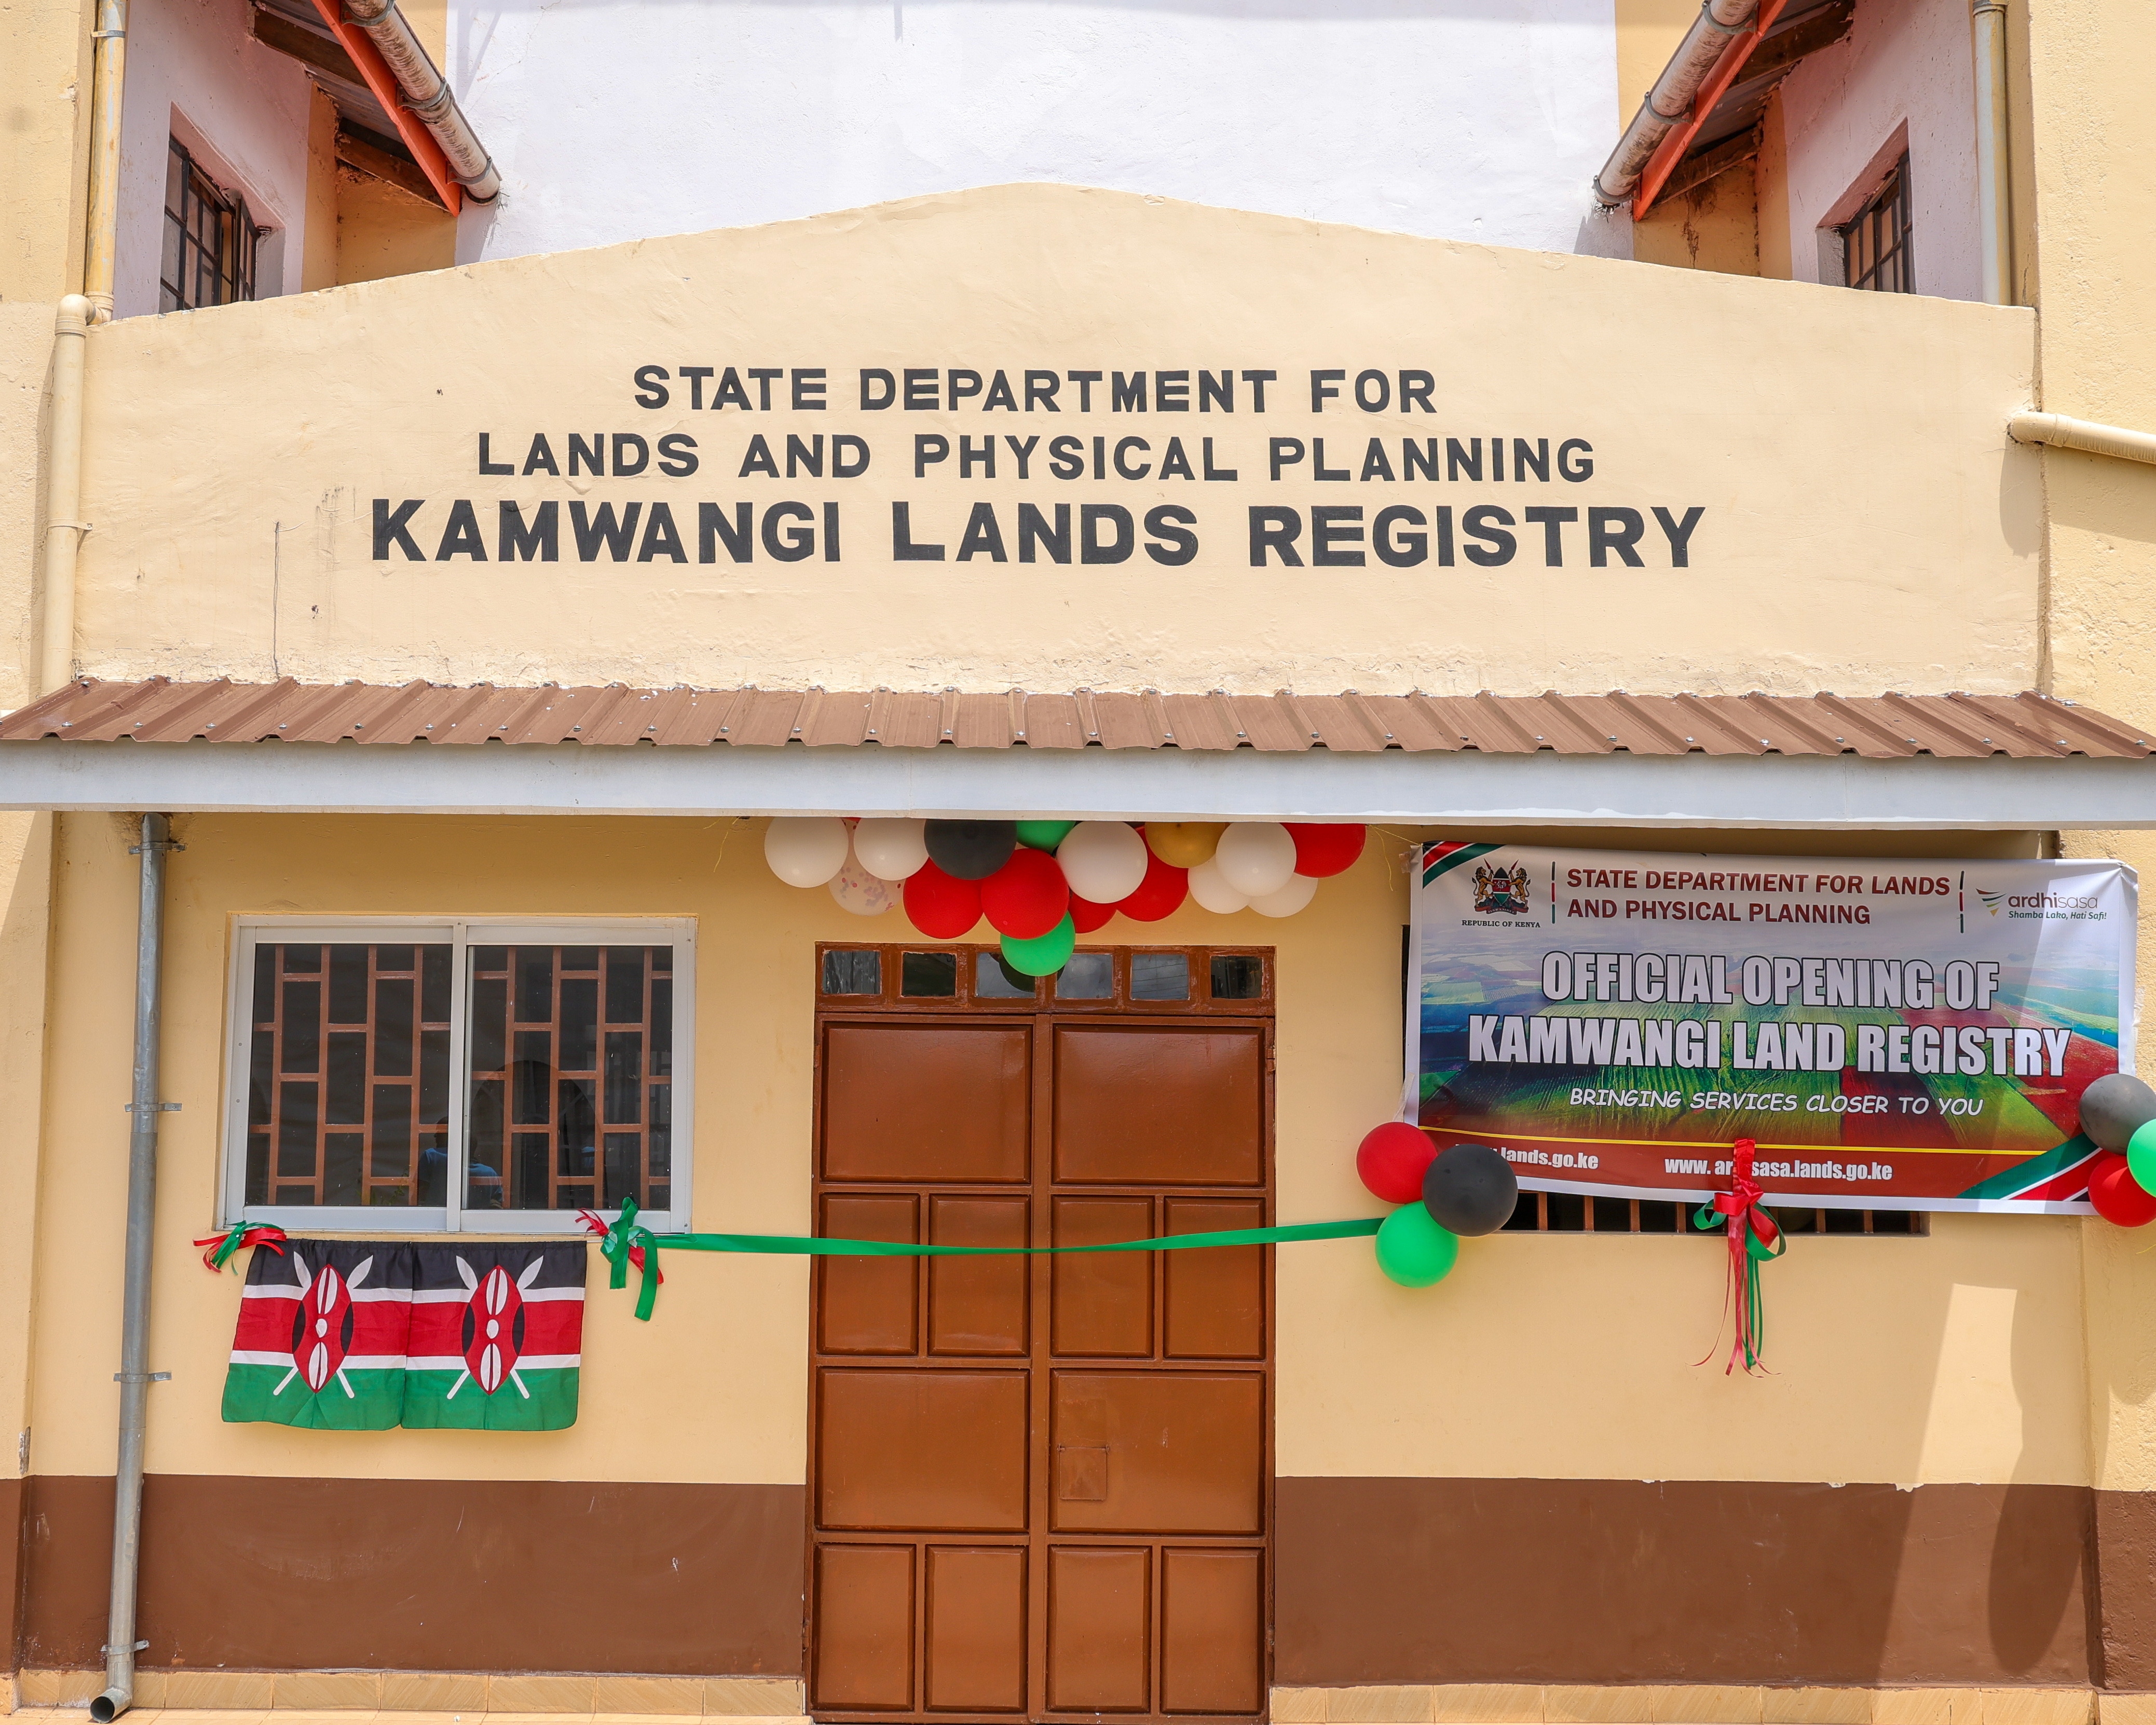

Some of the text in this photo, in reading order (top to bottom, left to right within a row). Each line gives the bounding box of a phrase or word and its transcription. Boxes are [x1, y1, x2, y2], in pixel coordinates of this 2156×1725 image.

[634, 365, 1437, 413] STATE DEPARTMENT FOR
[480, 433, 1593, 483] LANDS AND PHYSICAL PLANNING
[373, 499, 1705, 568] KAMWANGI LANDS REGISTRY
[1567, 868, 1950, 895] STATE DEPARTMENT FOR LANDS
[1567, 899, 1870, 924] AND PHYSICAL PLANNING
[2008, 892, 2098, 908] ardhisasa
[2008, 911, 2043, 919] Shamba
[2046, 912, 2068, 920] Lako,
[2088, 912, 2107, 921] Safi!
[1542, 951, 1999, 1011] OFFICIAL OPENING OF
[1468, 1014, 2072, 1077] KAMWANGI LAND REGISTRY
[1570, 1088, 1984, 1116] BRINGING SERVICES CLOSER TO YOU
[1455, 1144, 1599, 1169] lands.go.ke
[1664, 1159, 1892, 1181] www. arsasa.lands.go.ke
